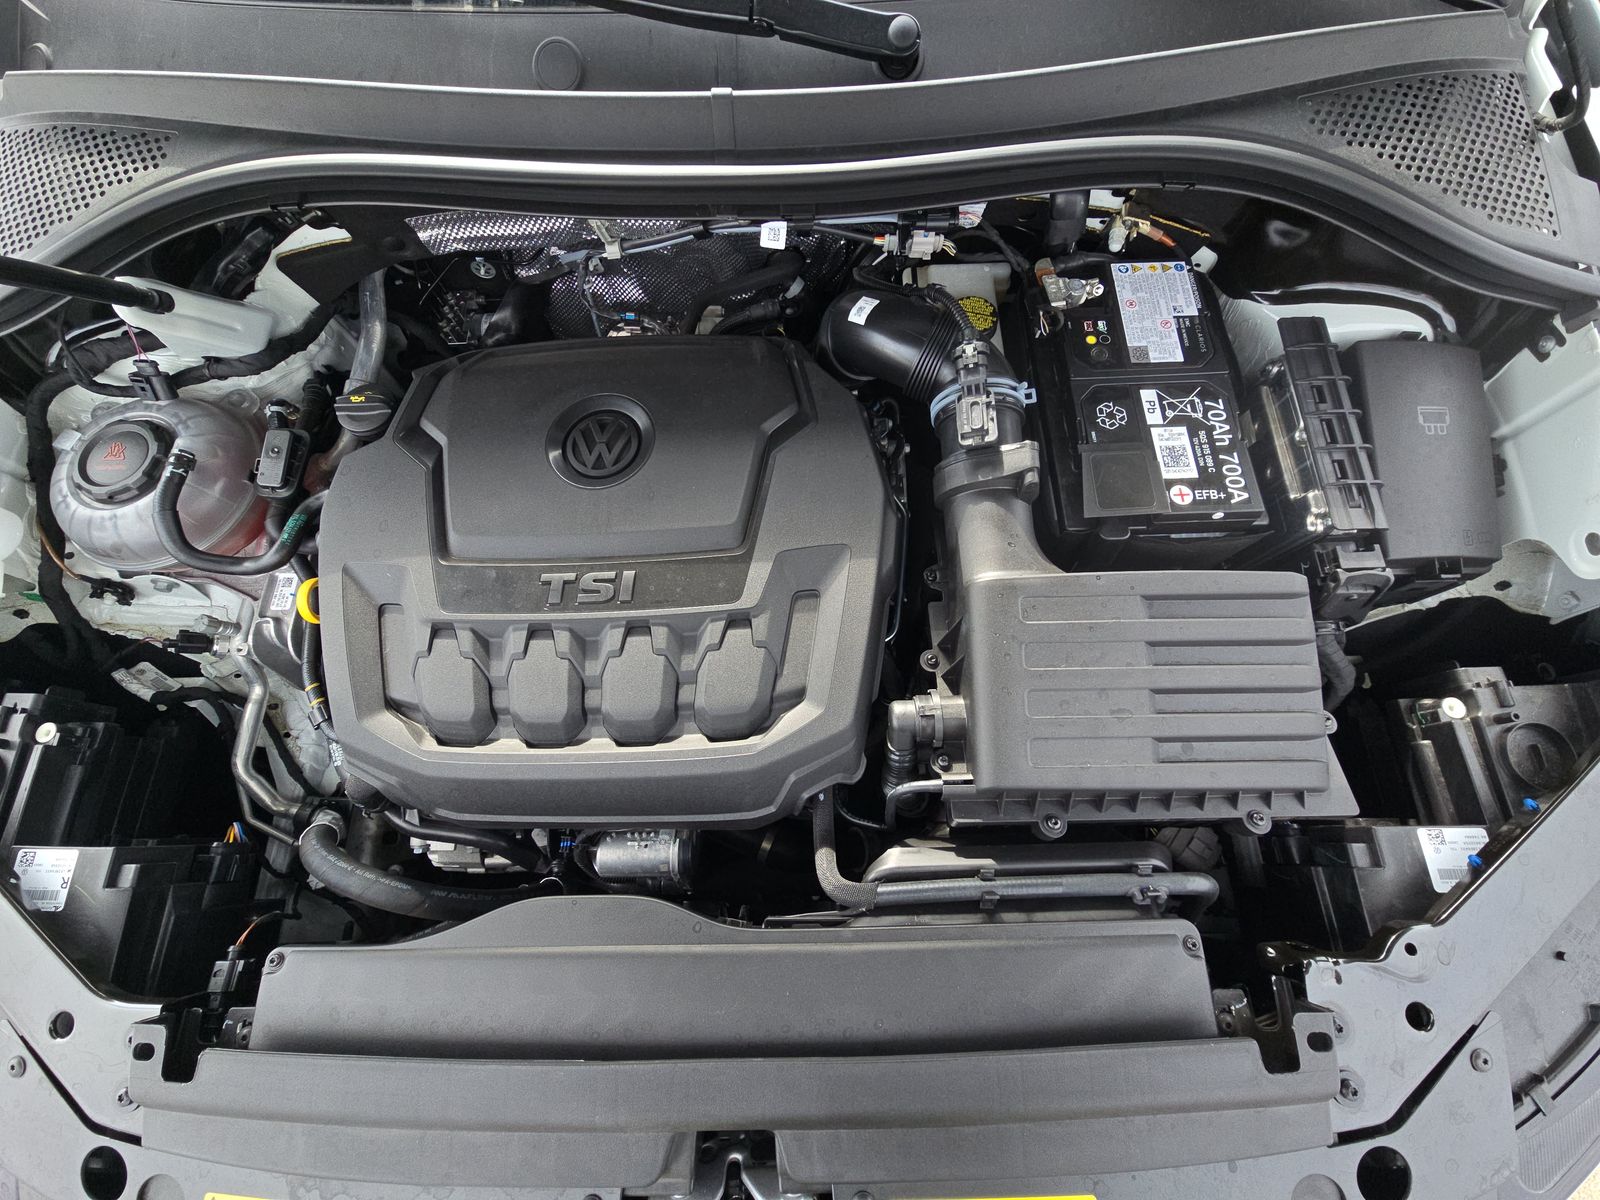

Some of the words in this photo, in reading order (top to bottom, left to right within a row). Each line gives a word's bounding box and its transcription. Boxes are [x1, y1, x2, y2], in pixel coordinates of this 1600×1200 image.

[1195, 324, 1207, 352] CLARIOS
[1145, 400, 1156, 414] Pb
[1204, 399, 1233, 446] 70Ah
[1219, 452, 1250, 504] 700A
[1194, 489, 1226, 500] EFB+
[539, 570, 637, 607] TSI
[60, 877, 70, 889] R
